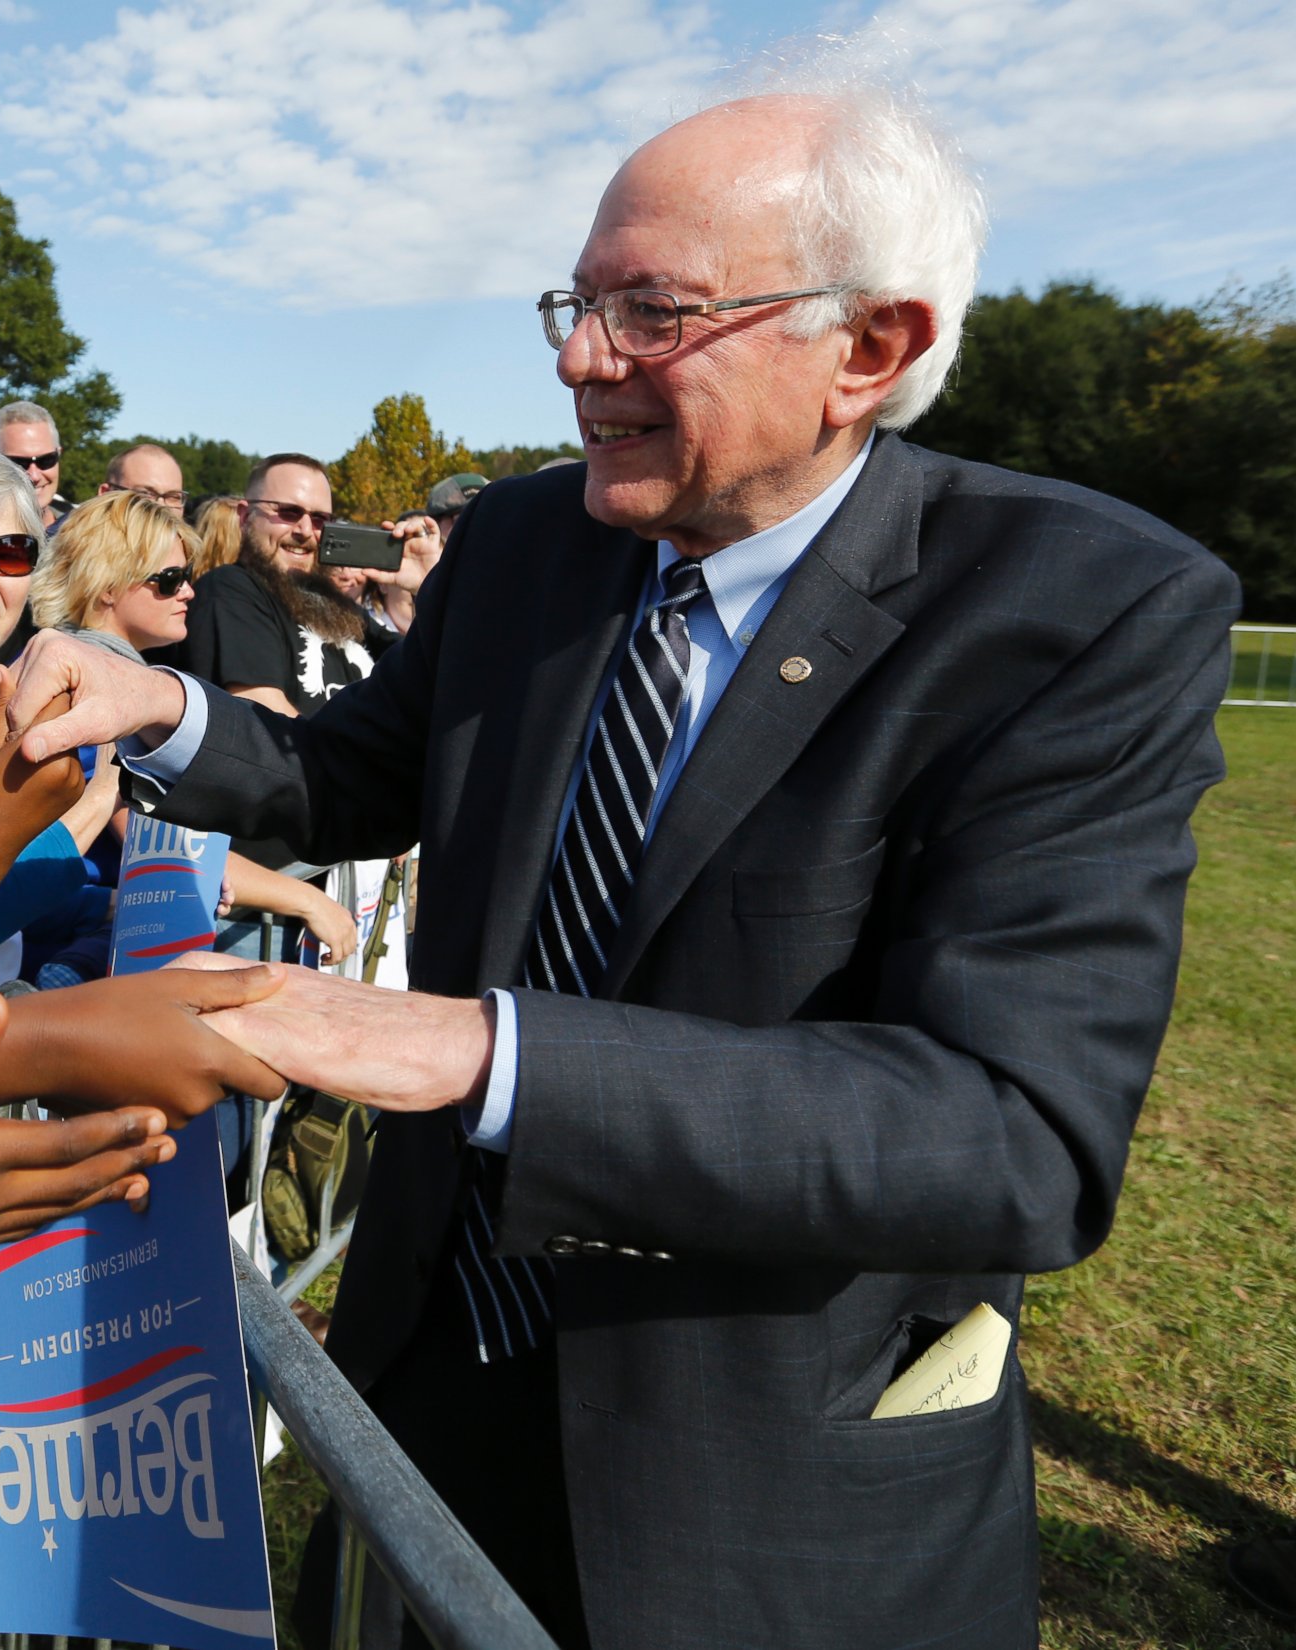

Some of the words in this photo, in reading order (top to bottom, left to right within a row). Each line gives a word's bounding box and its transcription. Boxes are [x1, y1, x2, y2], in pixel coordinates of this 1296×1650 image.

[123, 890, 176, 908] PRESIDENT
[23, 1238, 159, 1302] BERNIESANDERS.COM
[140, 1299, 173, 1335] FOR
[20, 1314, 133, 1366] PRESIDENT
